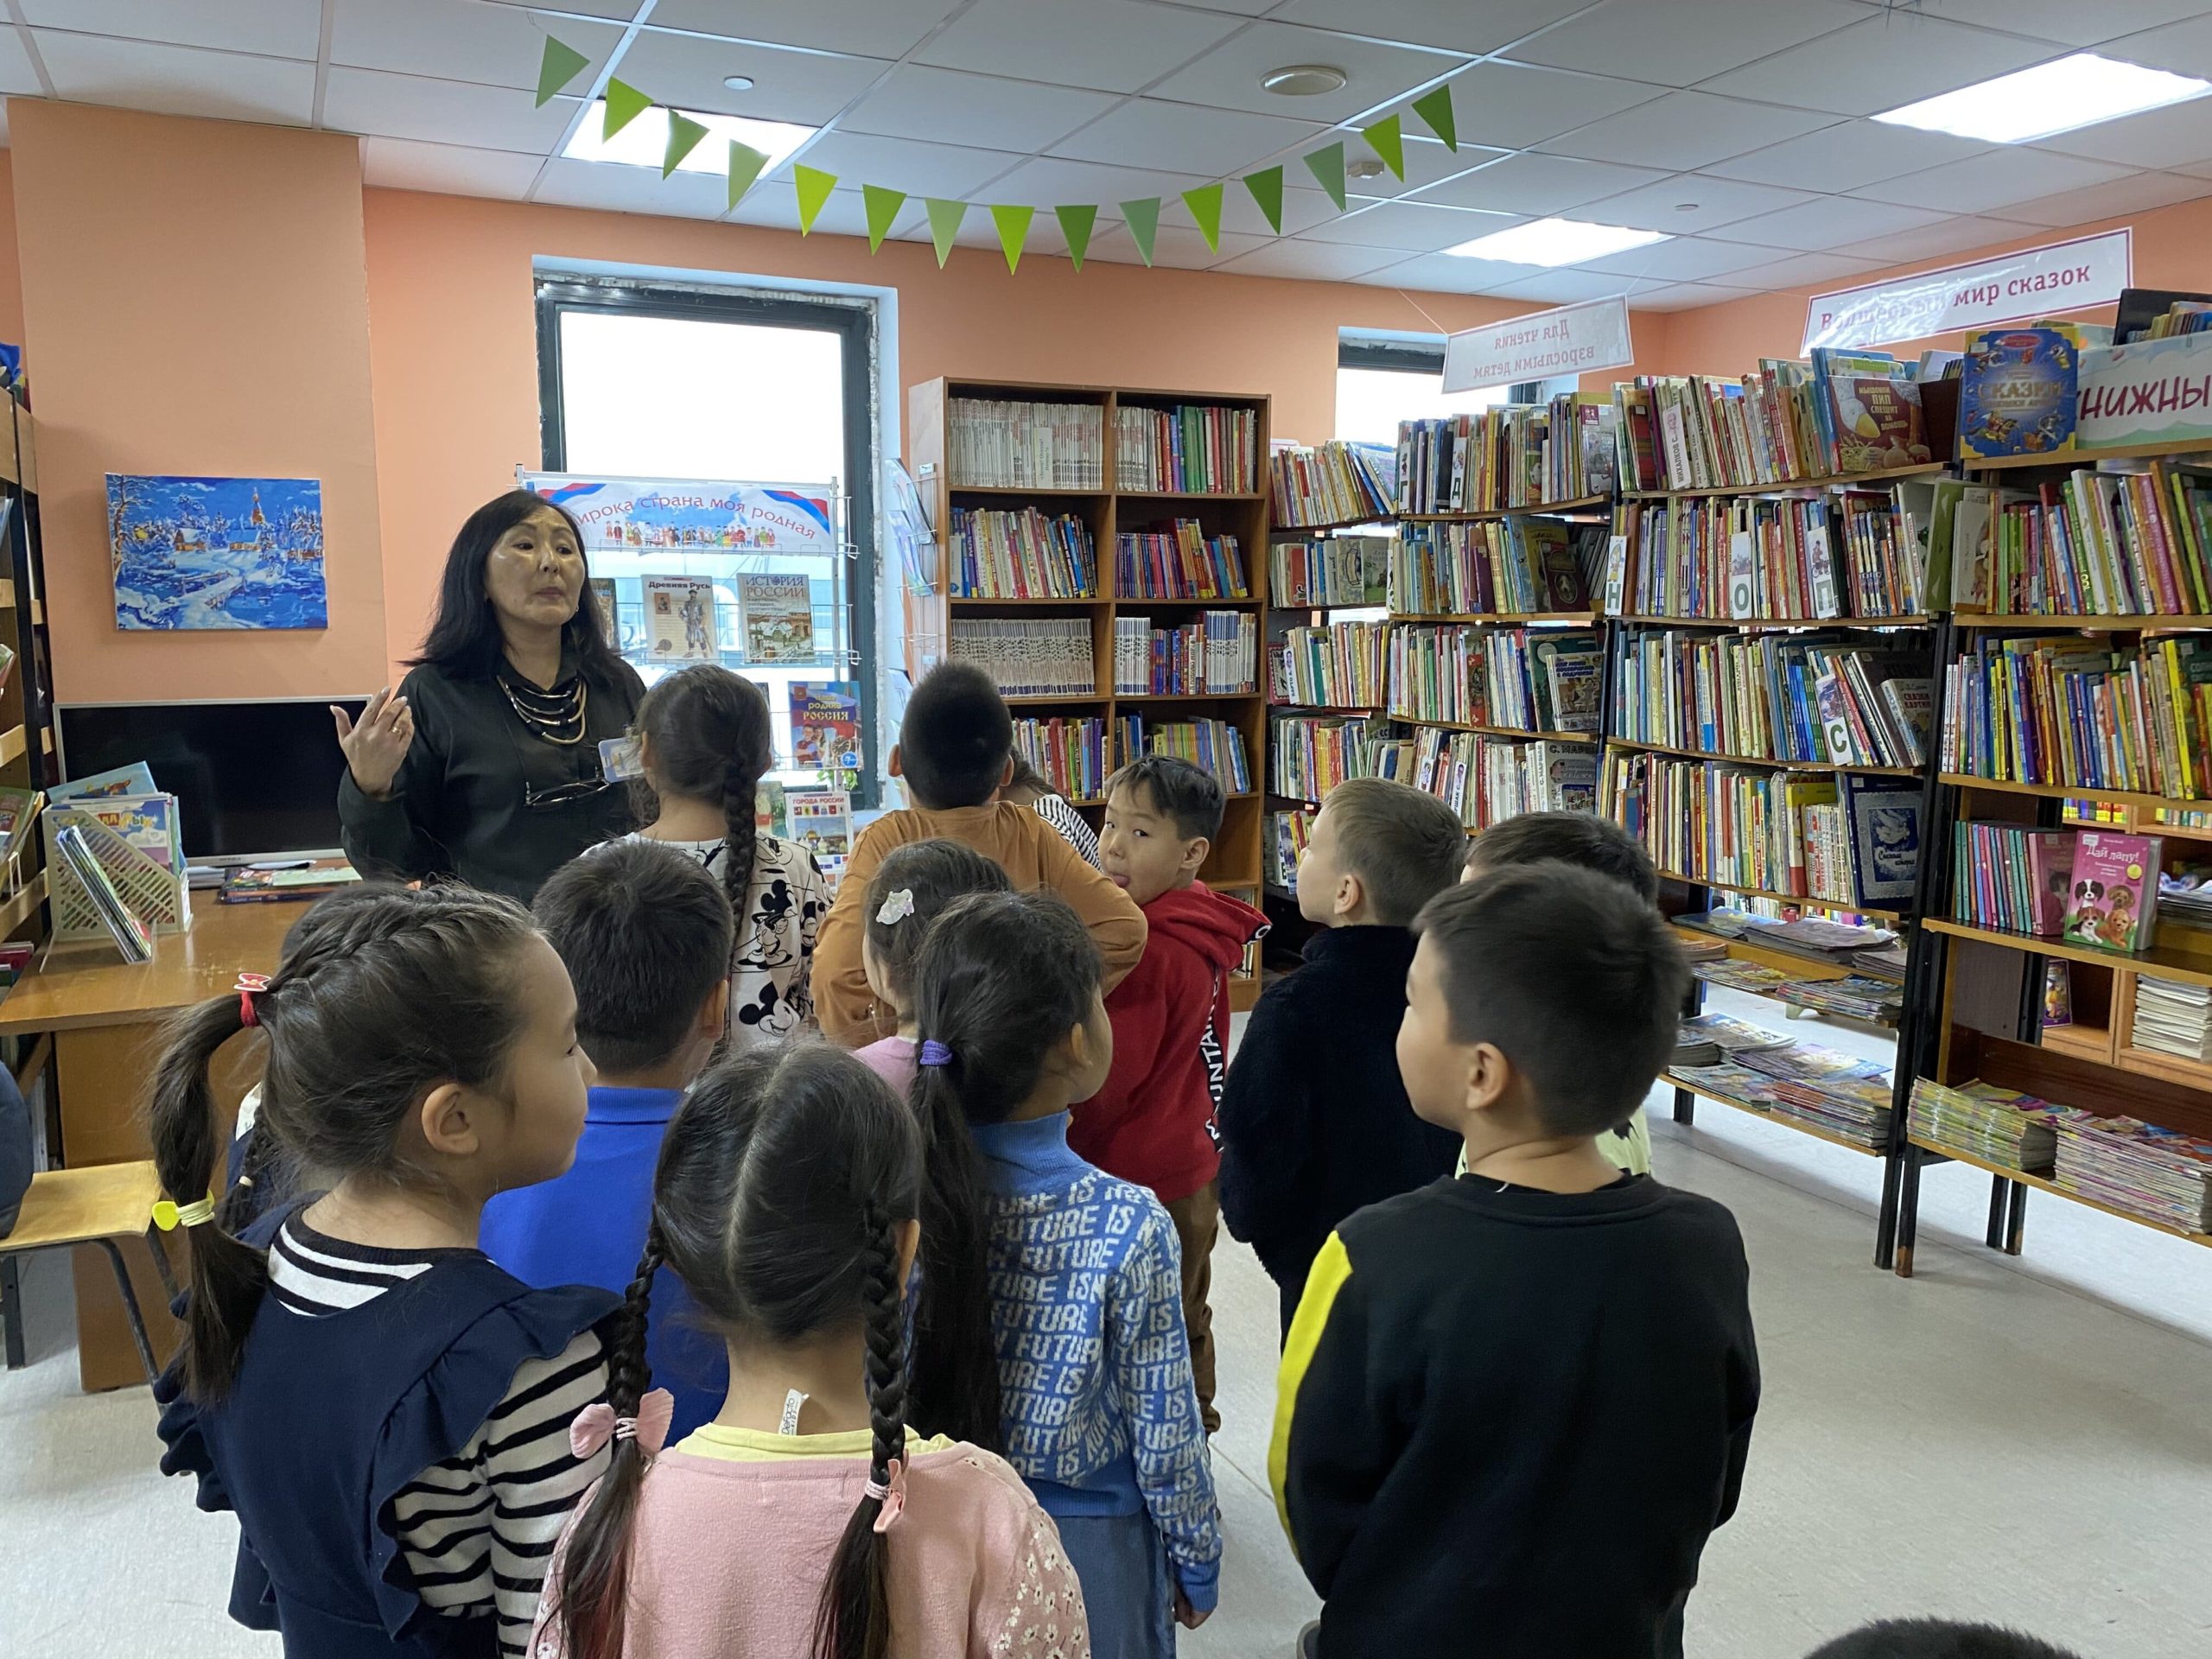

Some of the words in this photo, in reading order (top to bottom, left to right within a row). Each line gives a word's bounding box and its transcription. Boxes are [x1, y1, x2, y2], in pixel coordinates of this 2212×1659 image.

[1953, 281, 1999, 307] мир
[2006, 264, 2090, 297] сказок
[1870, 405, 1898, 414] СПЕШИТ
[1872, 394, 1891, 405] ПИП
[2076, 374, 2212, 422] НИЖНЫ
[1672, 442, 1685, 483] МИХАЛКОВ
[1452, 480, 1462, 501] Д
[576, 500, 634, 526] ирока
[640, 495, 704, 512] страна
[709, 499, 746, 513] моя
[751, 506, 817, 540] родная
[648, 581, 688, 589] Древняя
[690, 582, 711, 591] Русь
[745, 575, 804, 587] ИСТОРИЯ
[746, 587, 805, 598] РОССИИ
[1607, 583, 1622, 608] Н
[1733, 582, 1749, 612] О
[803, 711, 849, 721] РОССИЯ
[808, 702, 842, 710] родина
[1549, 744, 1560, 753] С.
[1829, 723, 1848, 753] С
[2086, 845, 2107, 858] Дай
[2108, 851, 2140, 863] лапу!
[990, 1205, 1101, 1243] FUTURE
[1104, 1204, 1136, 1235] IS
[1020, 1237, 1121, 1274] FUTURE
[988, 1271, 1058, 1303] TURE
[1148, 1302, 1173, 1334] IS
[1015, 1332, 1103, 1364] FUTUR
[1055, 1365, 1086, 1395] IS
[1117, 1357, 1191, 1392] FUTUR
[1164, 1389, 1187, 1420] IS
[1132, 1415, 1192, 1451] TURE
[1057, 1447, 1079, 1478] IS
